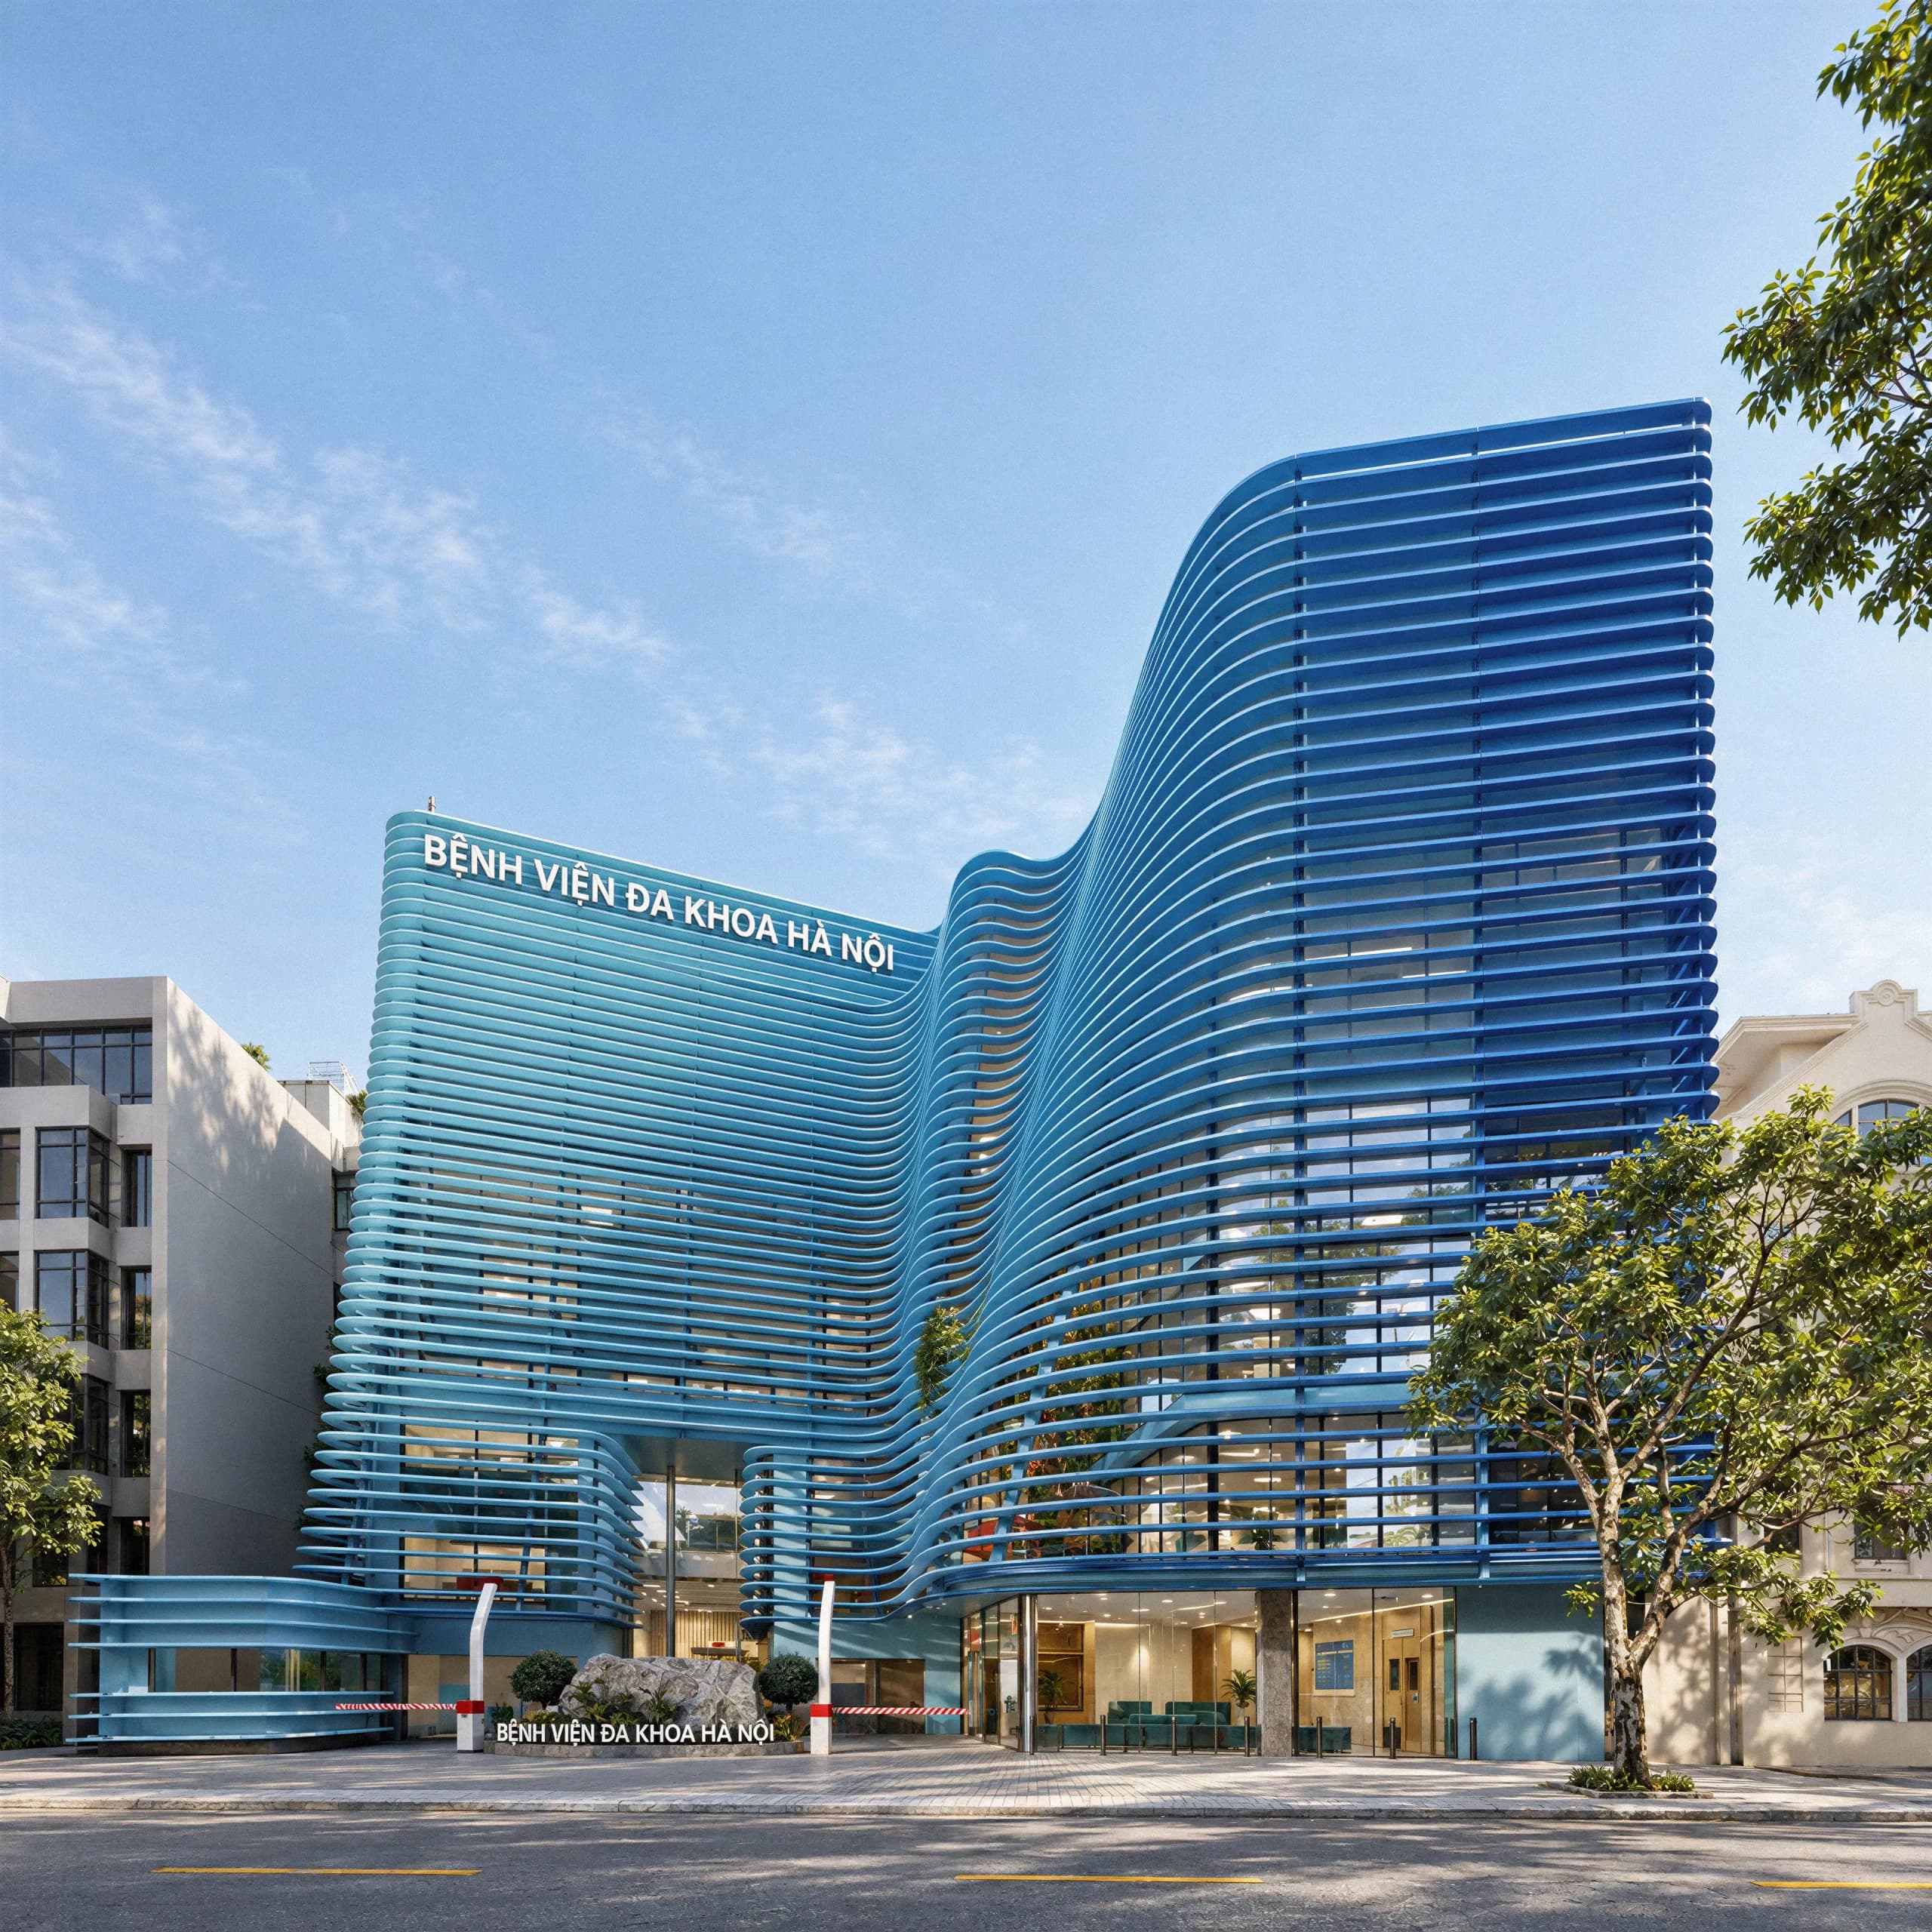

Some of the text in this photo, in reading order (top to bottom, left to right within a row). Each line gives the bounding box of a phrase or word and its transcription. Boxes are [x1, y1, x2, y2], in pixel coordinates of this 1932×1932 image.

[424, 832, 894, 972] BỆNH VIỆN ĐA KHOA HÀ NỘI
[497, 1718, 774, 1746] BỆNH VIỆN ĐA KHOA HÀ NỘI
